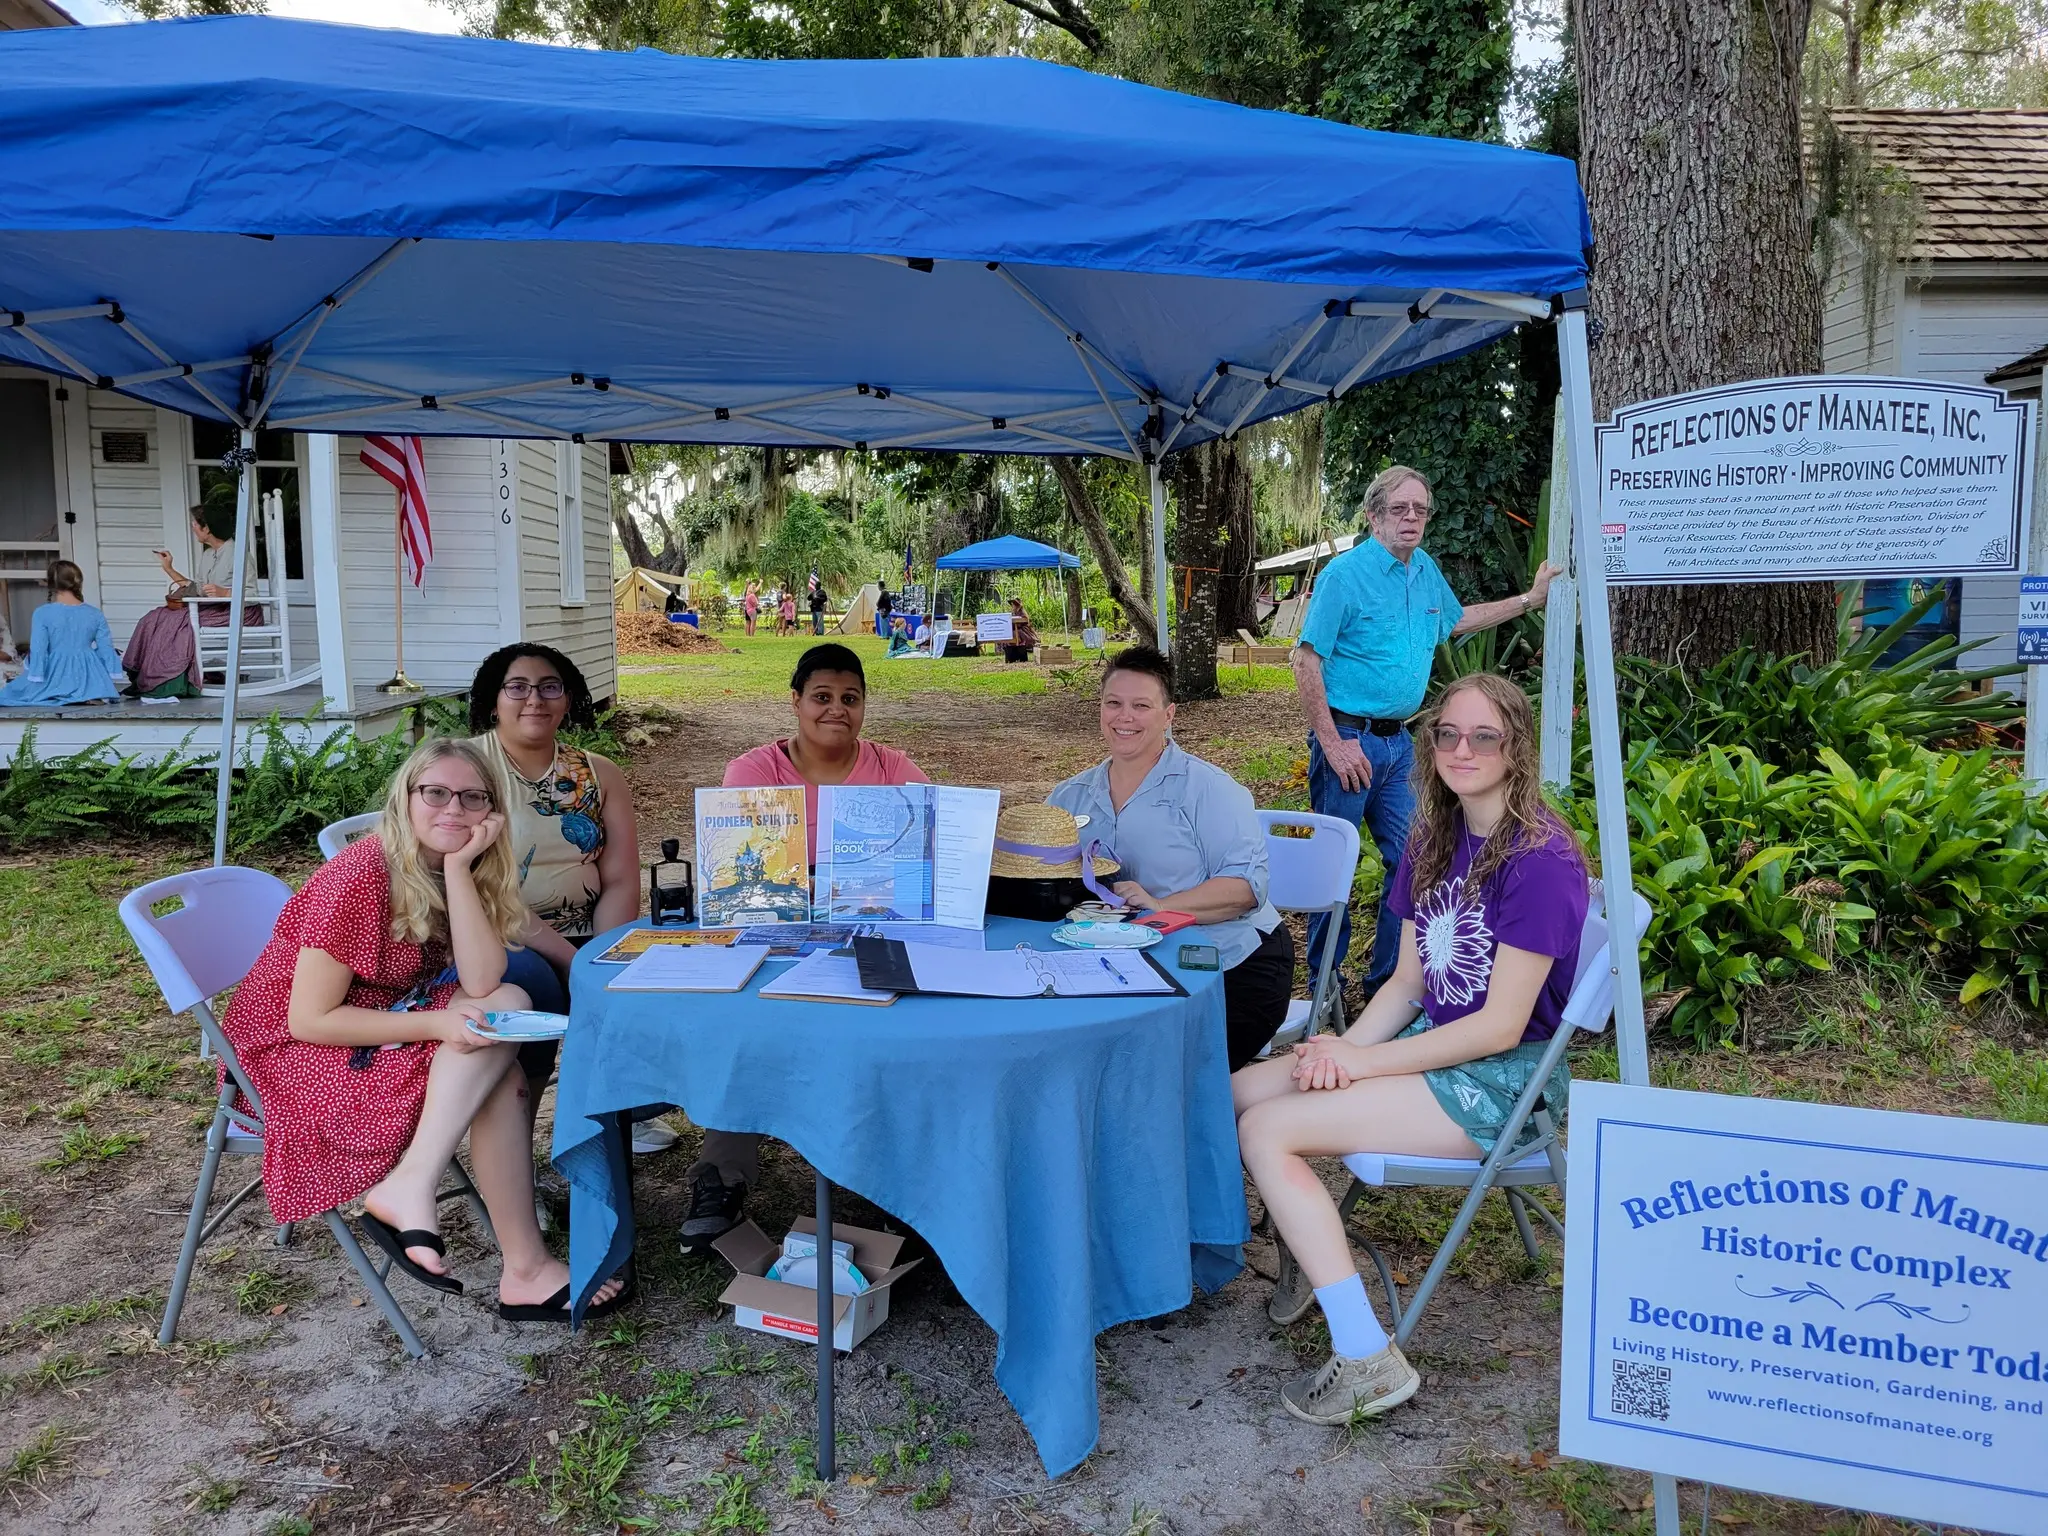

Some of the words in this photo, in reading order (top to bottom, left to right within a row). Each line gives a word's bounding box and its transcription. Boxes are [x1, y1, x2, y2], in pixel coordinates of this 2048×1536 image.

[1632, 403, 1776, 459] REFLECTIONS
[1782, 400, 1812, 433] OF
[1818, 393, 1935, 443] MANATEE,
[1943, 399, 1986, 443] INC.
[499, 440, 511, 525] 1306
[1610, 468, 1712, 490] PRESERVING
[1717, 464, 1788, 487] HISTORY
[1800, 459, 1895, 483] IMPROVING
[1900, 454, 2008, 479] COMMUNITY
[1618, 498, 1646, 507] These
[1648, 496, 1698, 506] museums
[1699, 495, 1730, 504] stand
[1754, 492, 1812, 502] monument
[1814, 491, 1826, 500] to
[1828, 490, 1842, 499] all
[1843, 489, 1873, 498] those
[1875, 488, 1899, 497] who
[1900, 486, 1938, 497] helped
[1939, 486, 1964, 494] save
[1966, 484, 1998, 493] them.
[1628, 510, 1648, 519] This
[1649, 509, 1684, 520] project
[1686, 508, 1705, 517] has
[1707, 507, 1731, 516] been
[1733, 505, 1779, 515] financed
[1779, 505, 1790, 513] in
[1791, 504, 1816, 515] part
[1818, 503, 1841, 512] with
[1844, 501, 1885, 511] Historic
[1887, 498, 1953, 509] Preservation
[1956, 497, 1988, 507] Grant
[1628, 522, 1680, 532] assistance
[1681, 520, 1726, 531] provided
[1726, 520, 1739, 530] by
[1741, 519, 1759, 527] the
[1761, 518, 1798, 527] Bureau
[1800, 517, 1813, 526] of
[1813, 516, 1854, 525] Historic
[1856, 513, 1924, 524] Preservation,
[1927, 511, 1970, 521] Division
[1972, 510, 1987, 519] of
[1637, 534, 1686, 543] Historical
[1686, 533, 1738, 542] Resources,
[1740, 531, 1776, 540] Florida
[1778, 529, 1841, 540] Department
[1843, 528, 1858, 537] of
[1857, 527, 1887, 536] State
[1888, 525, 1933, 535] assisted
[1935, 525, 1949, 535] by
[1951, 524, 1969, 533] the
[1663, 546, 1697, 555] Florida
[1699, 544, 1747, 554] Historical
[1748, 543, 1814, 553] Commission,
[1816, 542, 1839, 551] and
[1840, 541, 1854, 551] by
[1855, 540, 1874, 549] the
[1874, 538, 1931, 551] generosity
[1932, 538, 1947, 547] of
[1667, 558, 1687, 567] Hall
[1688, 557, 1740, 567] Architects
[1741, 556, 1763, 565] and
[1763, 557, 1794, 566] many
[1796, 555, 1825, 564] other
[1826, 553, 1878, 563] dedicated
[1879, 551, 1938, 561] individuals.
[2022, 582, 2048, 590] PROT
[2030, 601, 2048, 611] VI
[705, 815, 754, 829] PIONEER
[756, 813, 799, 827] SPIRITS
[834, 844, 864, 853] BOOK
[1452, 1083, 1470, 1112] Reebok
[1620, 1169, 1850, 1229] Reflections
[1860, 1178, 1909, 1213] of
[1700, 1225, 1842, 1268] Historic
[1850, 1245, 2012, 1289] Complex
[1628, 1296, 1764, 1342] Become
[1772, 1323, 1793, 1346] a
[1801, 1322, 1960, 1370] Member
[1612, 1336, 1667, 1361] Living
[1672, 1346, 1744, 1373] History,
[1750, 1358, 1881, 1394] Preservation,
[1886, 1379, 1998, 1412] Gardening,
[2004, 1398, 2043, 1416] and
[1707, 1388, 1993, 1447] www.reflectionsofmanatee.org
